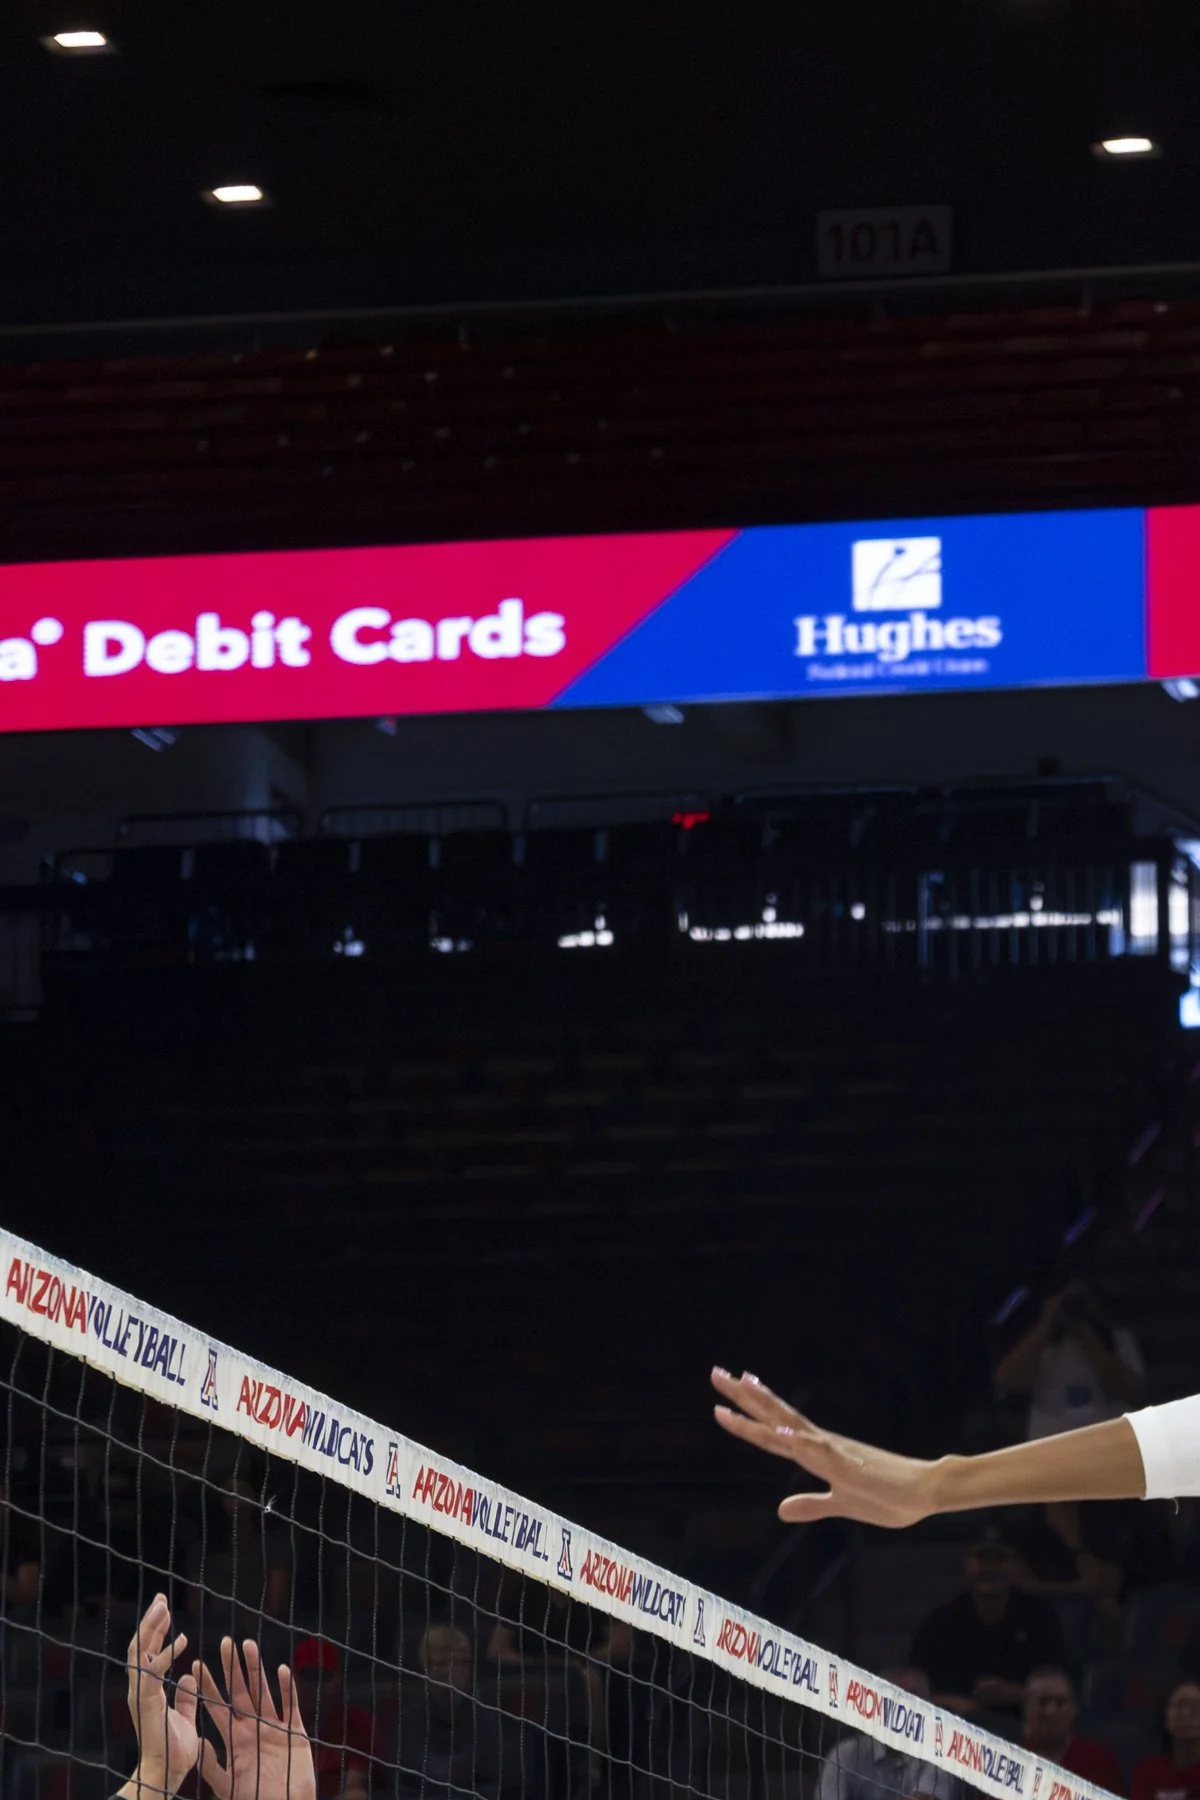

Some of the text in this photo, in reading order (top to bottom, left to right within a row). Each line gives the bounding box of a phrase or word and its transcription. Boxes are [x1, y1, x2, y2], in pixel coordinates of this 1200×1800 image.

[827, 218, 939, 264] 101A
[84, 611, 310, 677] Debit
[330, 599, 566, 665] Cards
[794, 611, 1003, 662] Hughes
